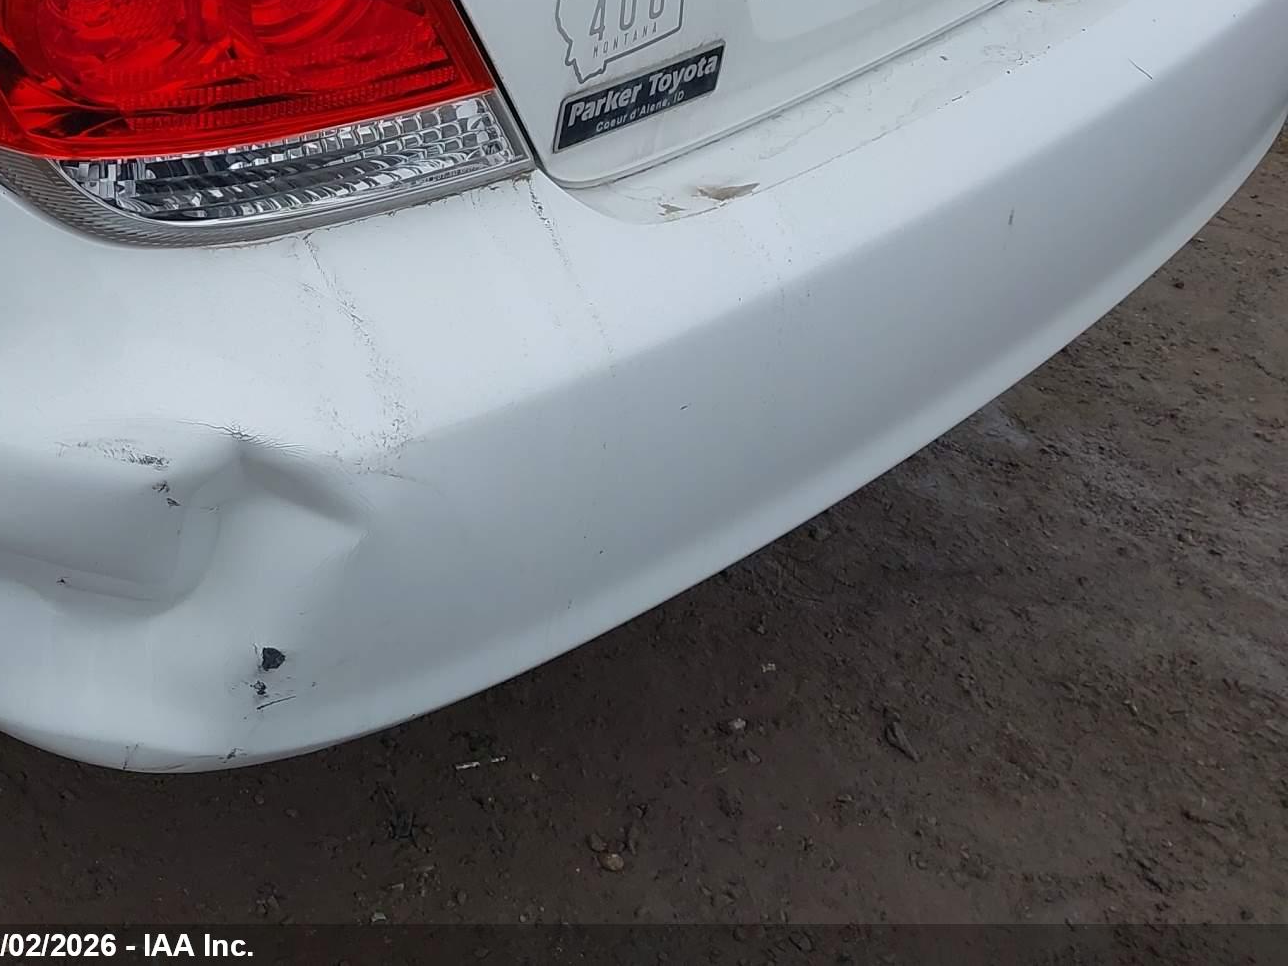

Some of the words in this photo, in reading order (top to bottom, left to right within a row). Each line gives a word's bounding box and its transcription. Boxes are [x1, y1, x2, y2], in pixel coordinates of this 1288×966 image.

[592, 21, 657, 59] MONTANA
[567, 83, 643, 127] Parker
[648, 55, 718, 96] Toyota
[596, 114, 628, 133] Coeur
